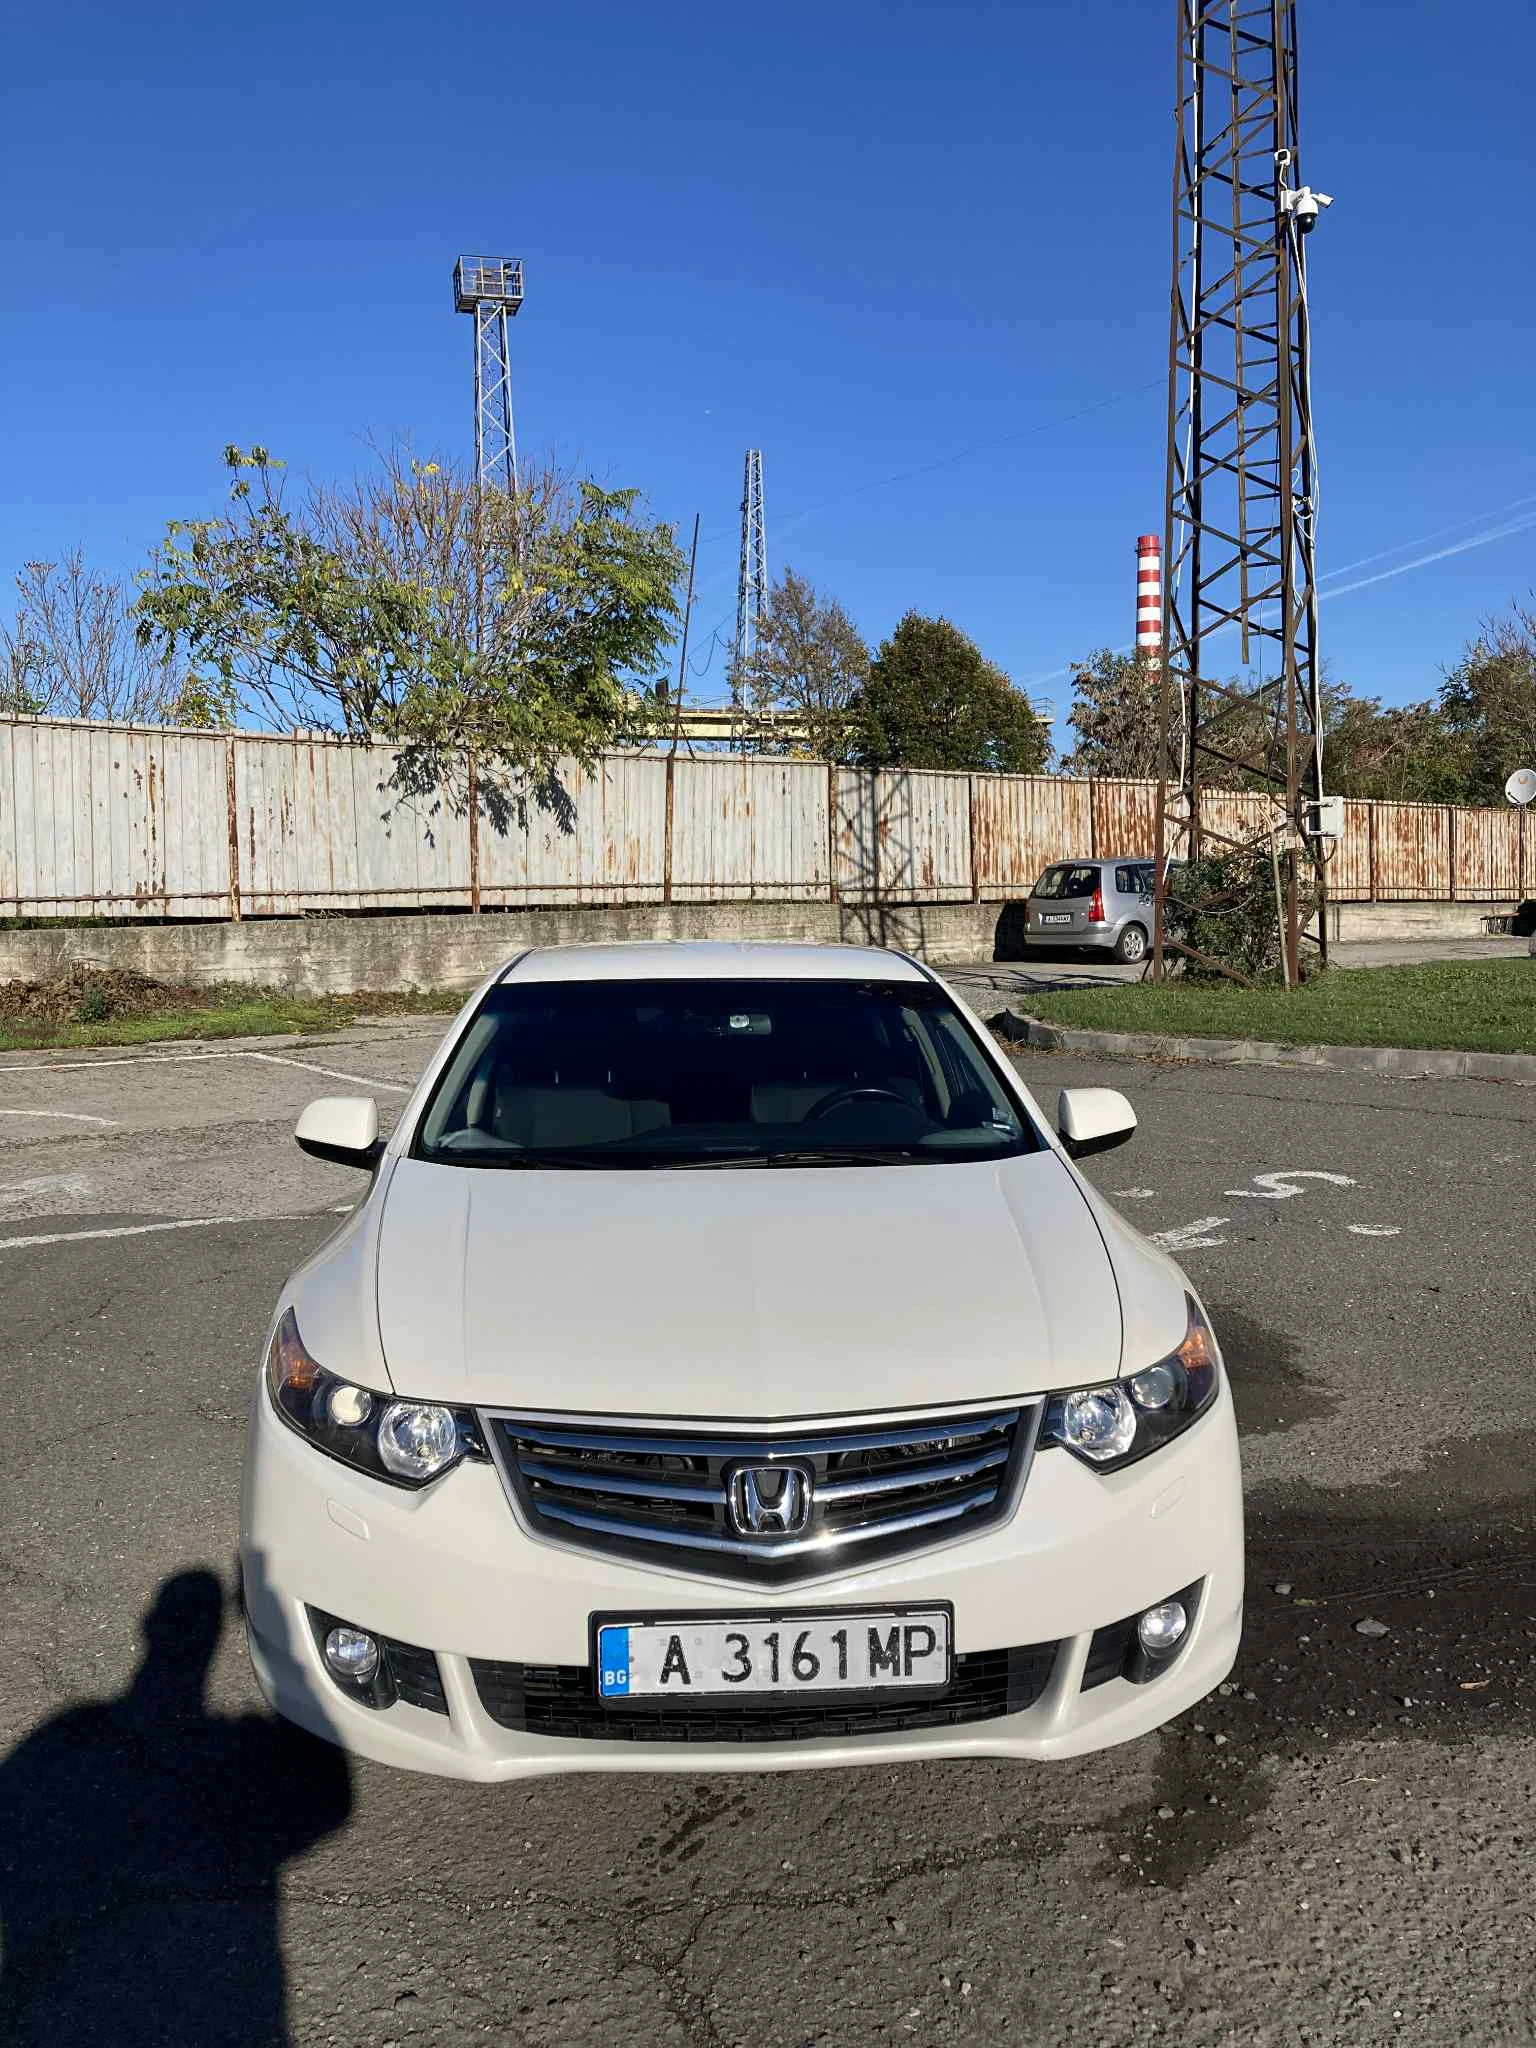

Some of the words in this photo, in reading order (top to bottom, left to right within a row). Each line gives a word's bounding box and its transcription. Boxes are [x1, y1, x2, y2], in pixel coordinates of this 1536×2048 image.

[659, 1634, 691, 1685] A
[721, 1630, 848, 1683] 3161
[867, 1625, 937, 1678] MP
[604, 1670, 627, 1686] BG
